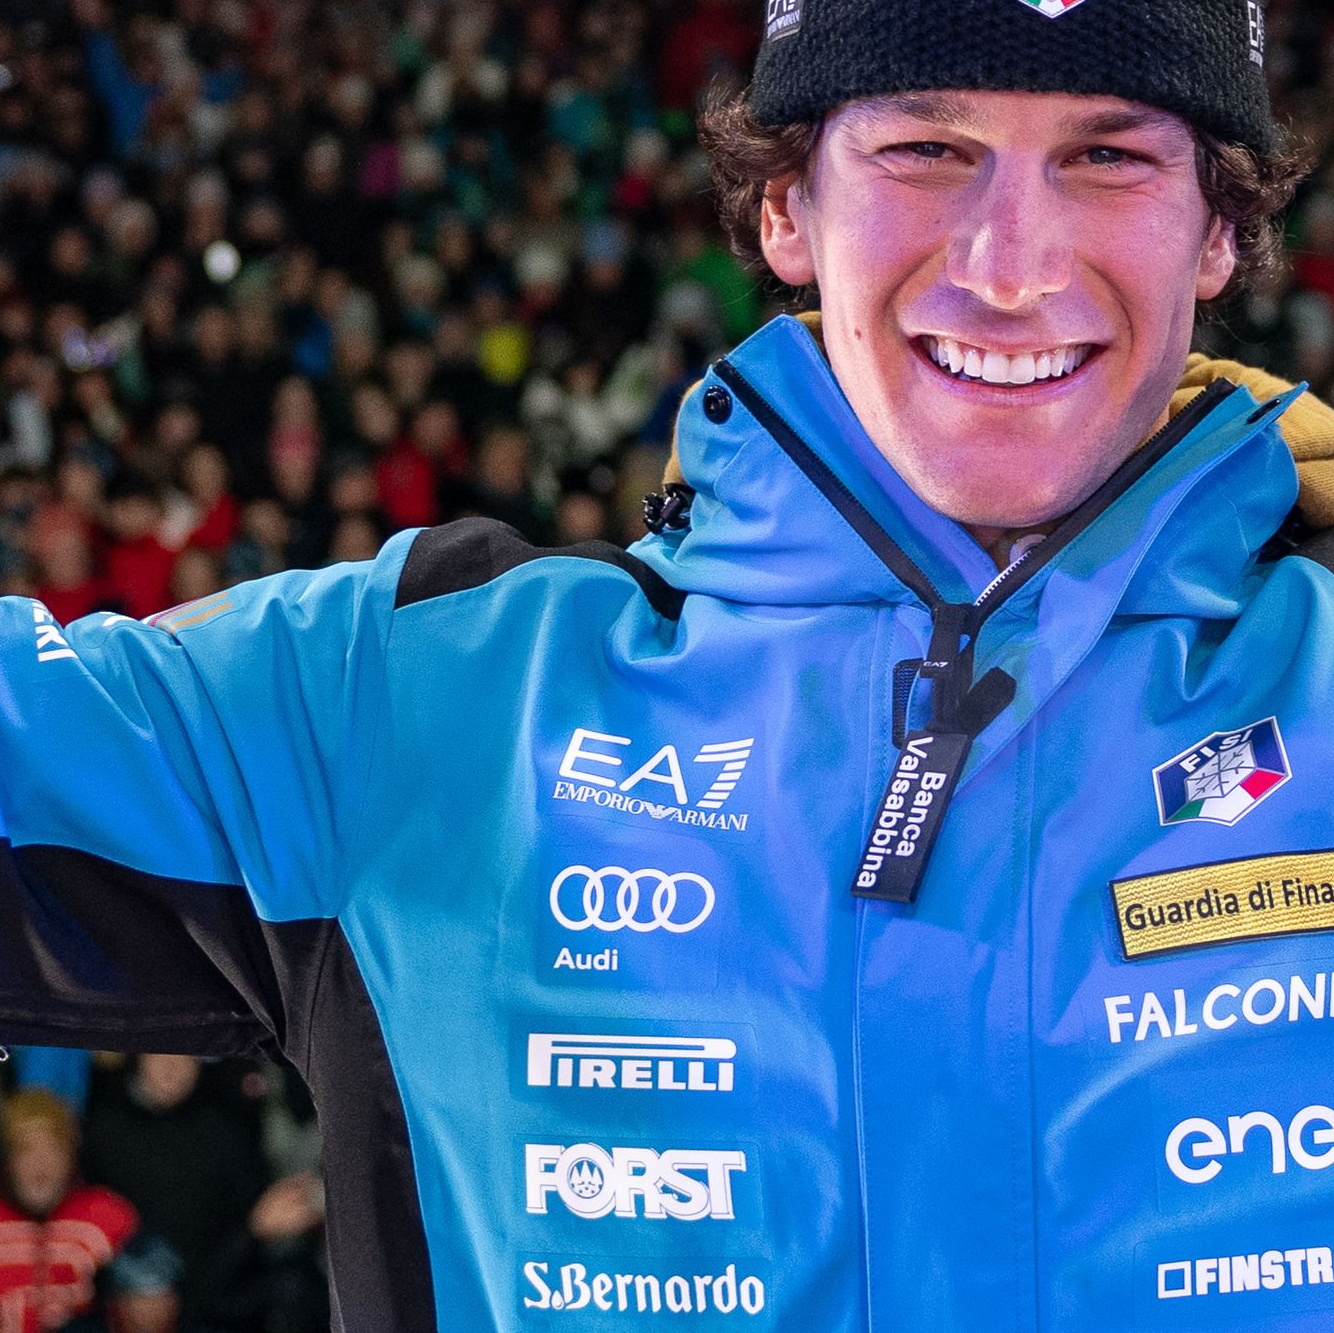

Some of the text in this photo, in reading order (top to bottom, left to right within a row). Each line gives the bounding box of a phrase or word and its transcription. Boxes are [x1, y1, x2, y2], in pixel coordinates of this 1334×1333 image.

[559, 728, 754, 808] EA7
[1179, 729, 1253, 773] FISI
[553, 781, 748, 831] EMPORIO ARMANI
[856, 736, 934, 888] Valsabbina
[895, 771, 947, 857] Banca
[1125, 888, 1239, 931] Guardia
[1248, 879, 1275, 910] di
[554, 947, 619, 971] Audi
[528, 1033, 737, 1091] PIRELLI
[525, 1143, 746, 1220] FORST
